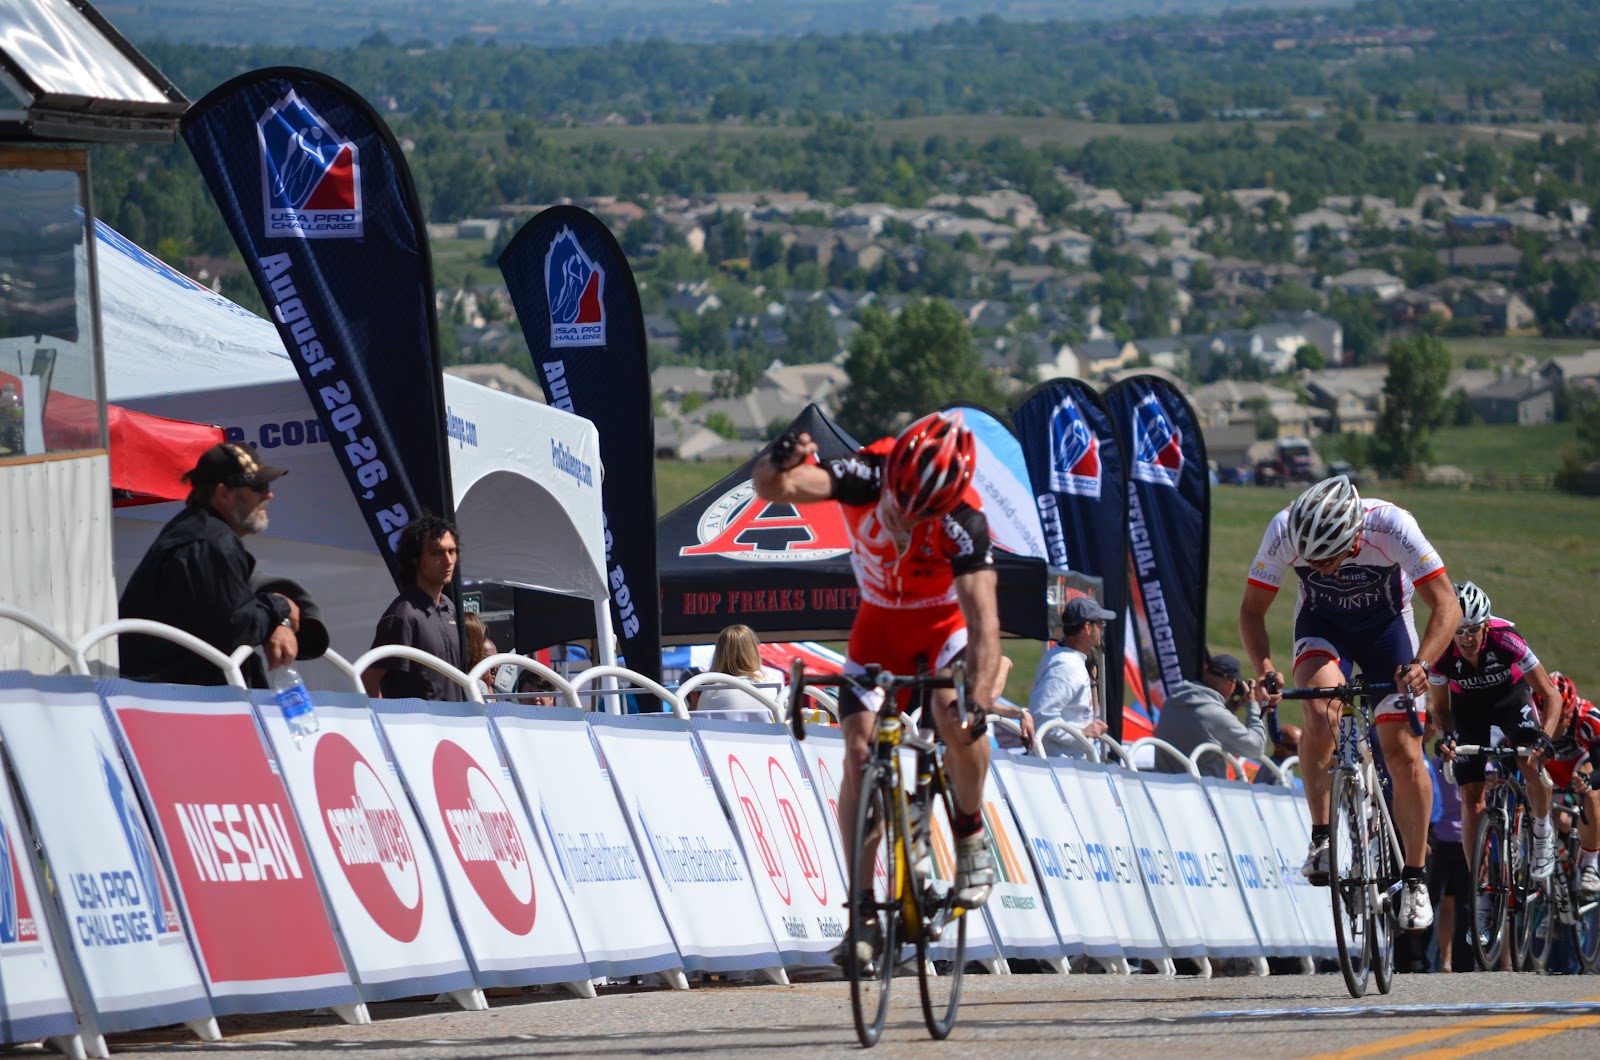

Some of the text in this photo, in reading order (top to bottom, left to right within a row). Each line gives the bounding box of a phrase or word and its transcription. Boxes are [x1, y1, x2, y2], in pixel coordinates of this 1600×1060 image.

[271, 213, 356, 222] USA PRO
[271, 222, 356, 230] CHALLENGE
[258, 251, 337, 378] August
[318, 379, 389, 500] 20-26,
[551, 437, 594, 488] ProChallenge.com
[682, 591, 722, 615] HOP
[726, 589, 806, 614] FREAKS
[174, 803, 303, 882] NISSAN
[326, 795, 412, 872] smashburger
[445, 797, 525, 870] smashburger
[69, 870, 141, 909] USA PRO
[76, 911, 153, 947] CHALLENGE
